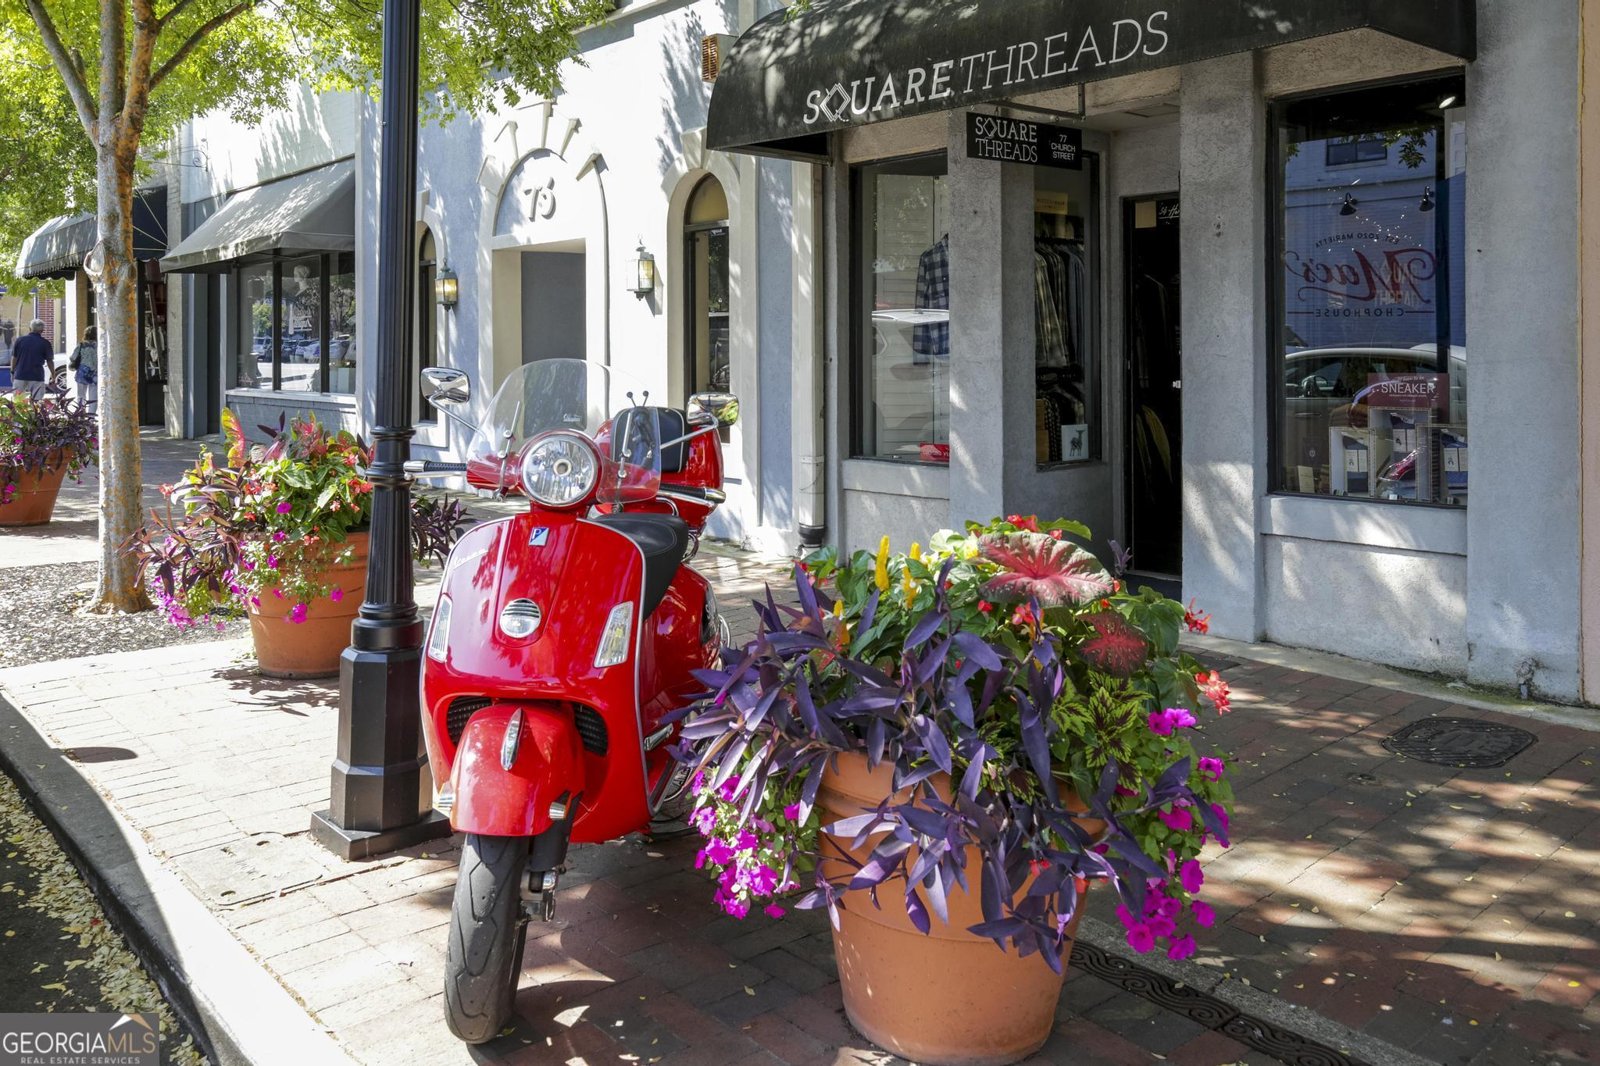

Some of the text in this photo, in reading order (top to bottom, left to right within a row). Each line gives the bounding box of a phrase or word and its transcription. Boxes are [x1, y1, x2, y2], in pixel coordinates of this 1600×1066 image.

[803, 11, 1169, 124] SQUARE THREADS
[975, 116, 1038, 142] SQUARE
[1059, 134, 1067, 143] 77
[975, 138, 1038, 163] THREADS
[1050, 142, 1076, 152] CHURCH
[1052, 150, 1075, 160] STREET
[1381, 382, 1435, 394] SNEAKER
